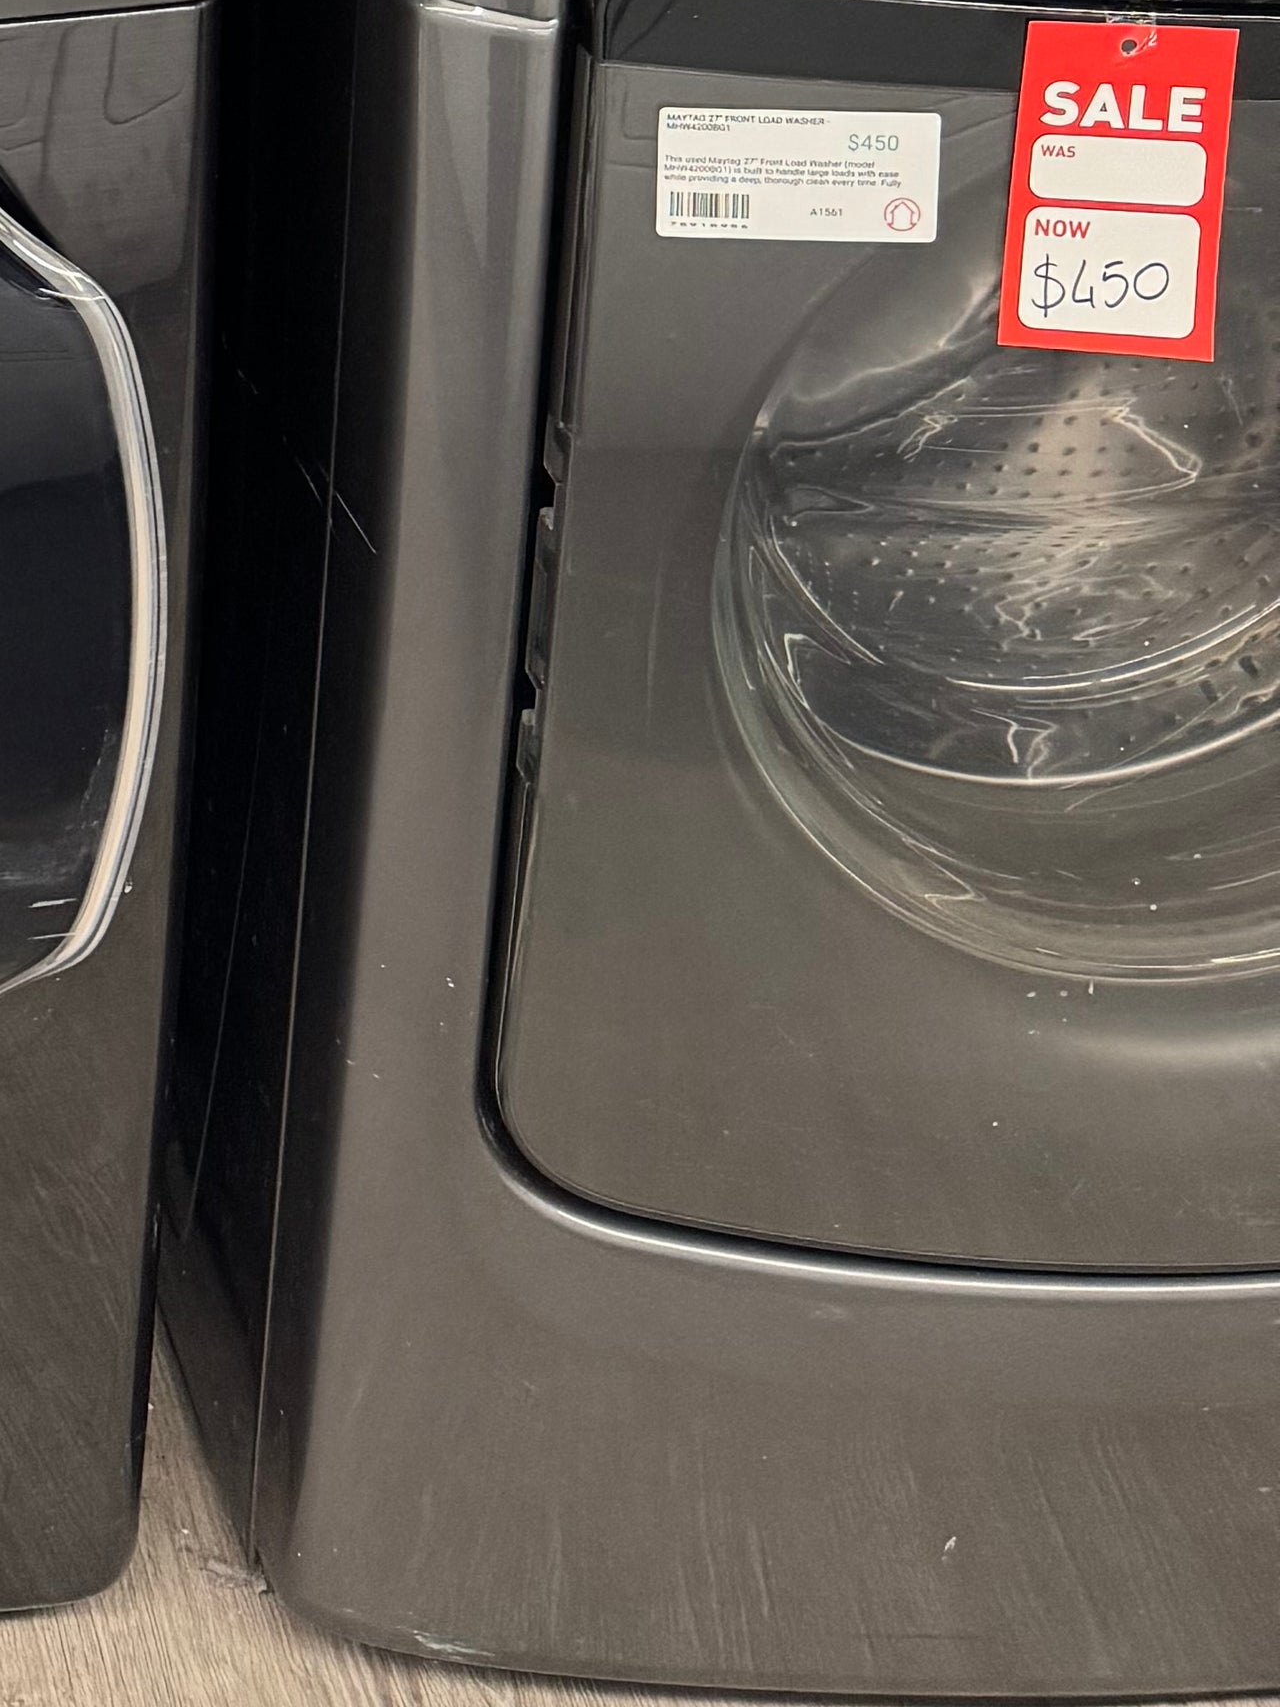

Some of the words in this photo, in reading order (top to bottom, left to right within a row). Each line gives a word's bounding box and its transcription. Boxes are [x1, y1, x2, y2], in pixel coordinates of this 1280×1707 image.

[1040, 81, 1206, 133] SALE
[667, 114, 705, 122] MAYTAG
[1041, 145, 1075, 158] WAS
[1035, 220, 1090, 238] NOW
[1031, 254, 1169, 318] $450
